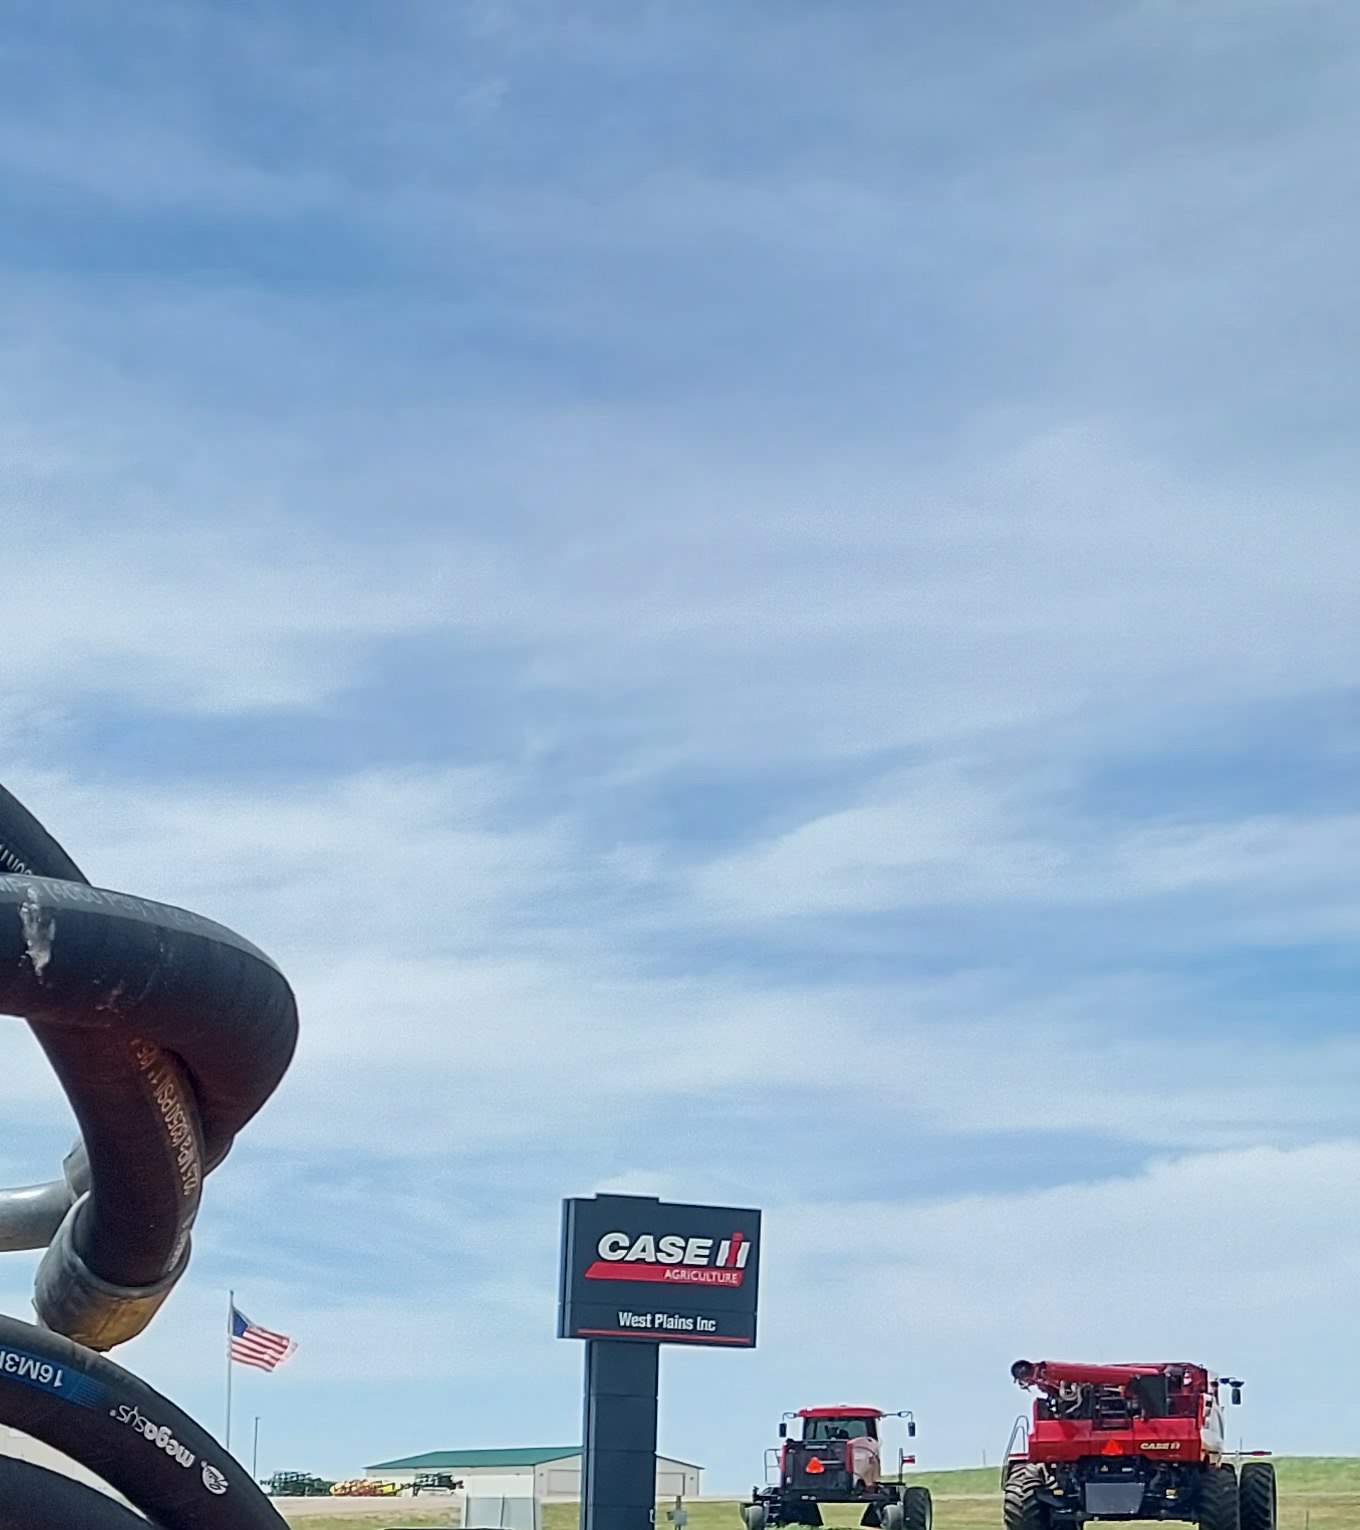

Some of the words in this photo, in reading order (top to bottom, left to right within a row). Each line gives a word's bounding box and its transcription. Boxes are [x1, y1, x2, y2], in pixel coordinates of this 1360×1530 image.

[598, 1232, 714, 1266] CASE
[664, 1269, 738, 1284] AGRICULTURE
[618, 1311, 651, 1328] West
[655, 1313, 694, 1331] Plains
[696, 1315, 717, 1332] Inc
